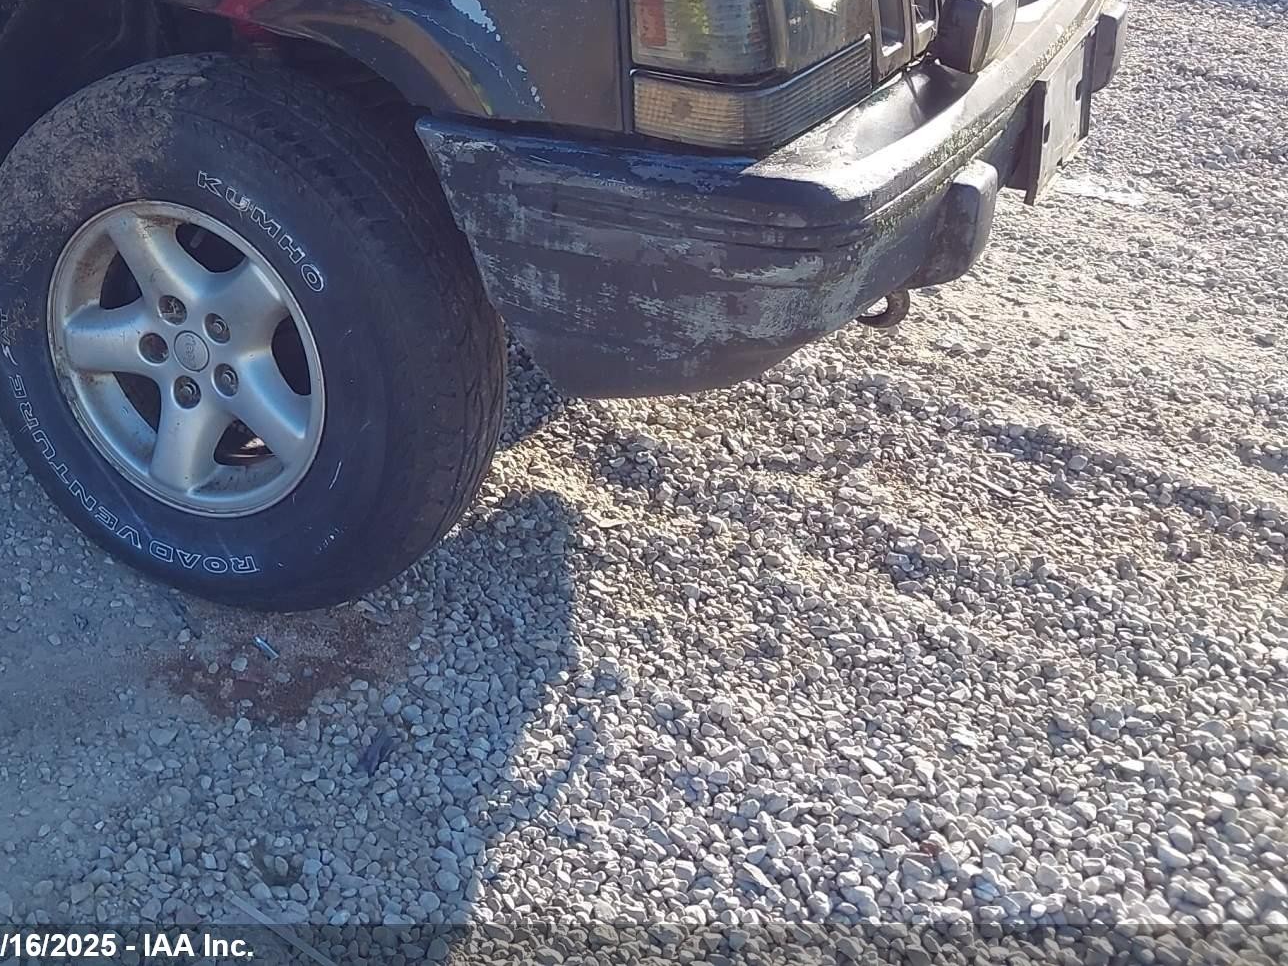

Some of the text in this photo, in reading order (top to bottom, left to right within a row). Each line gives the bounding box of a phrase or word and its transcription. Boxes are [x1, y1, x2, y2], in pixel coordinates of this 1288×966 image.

[197, 170, 324, 292] KUMHO
[9, 373, 142, 549] VENTURE
[149, 540, 260, 574] ROAD
